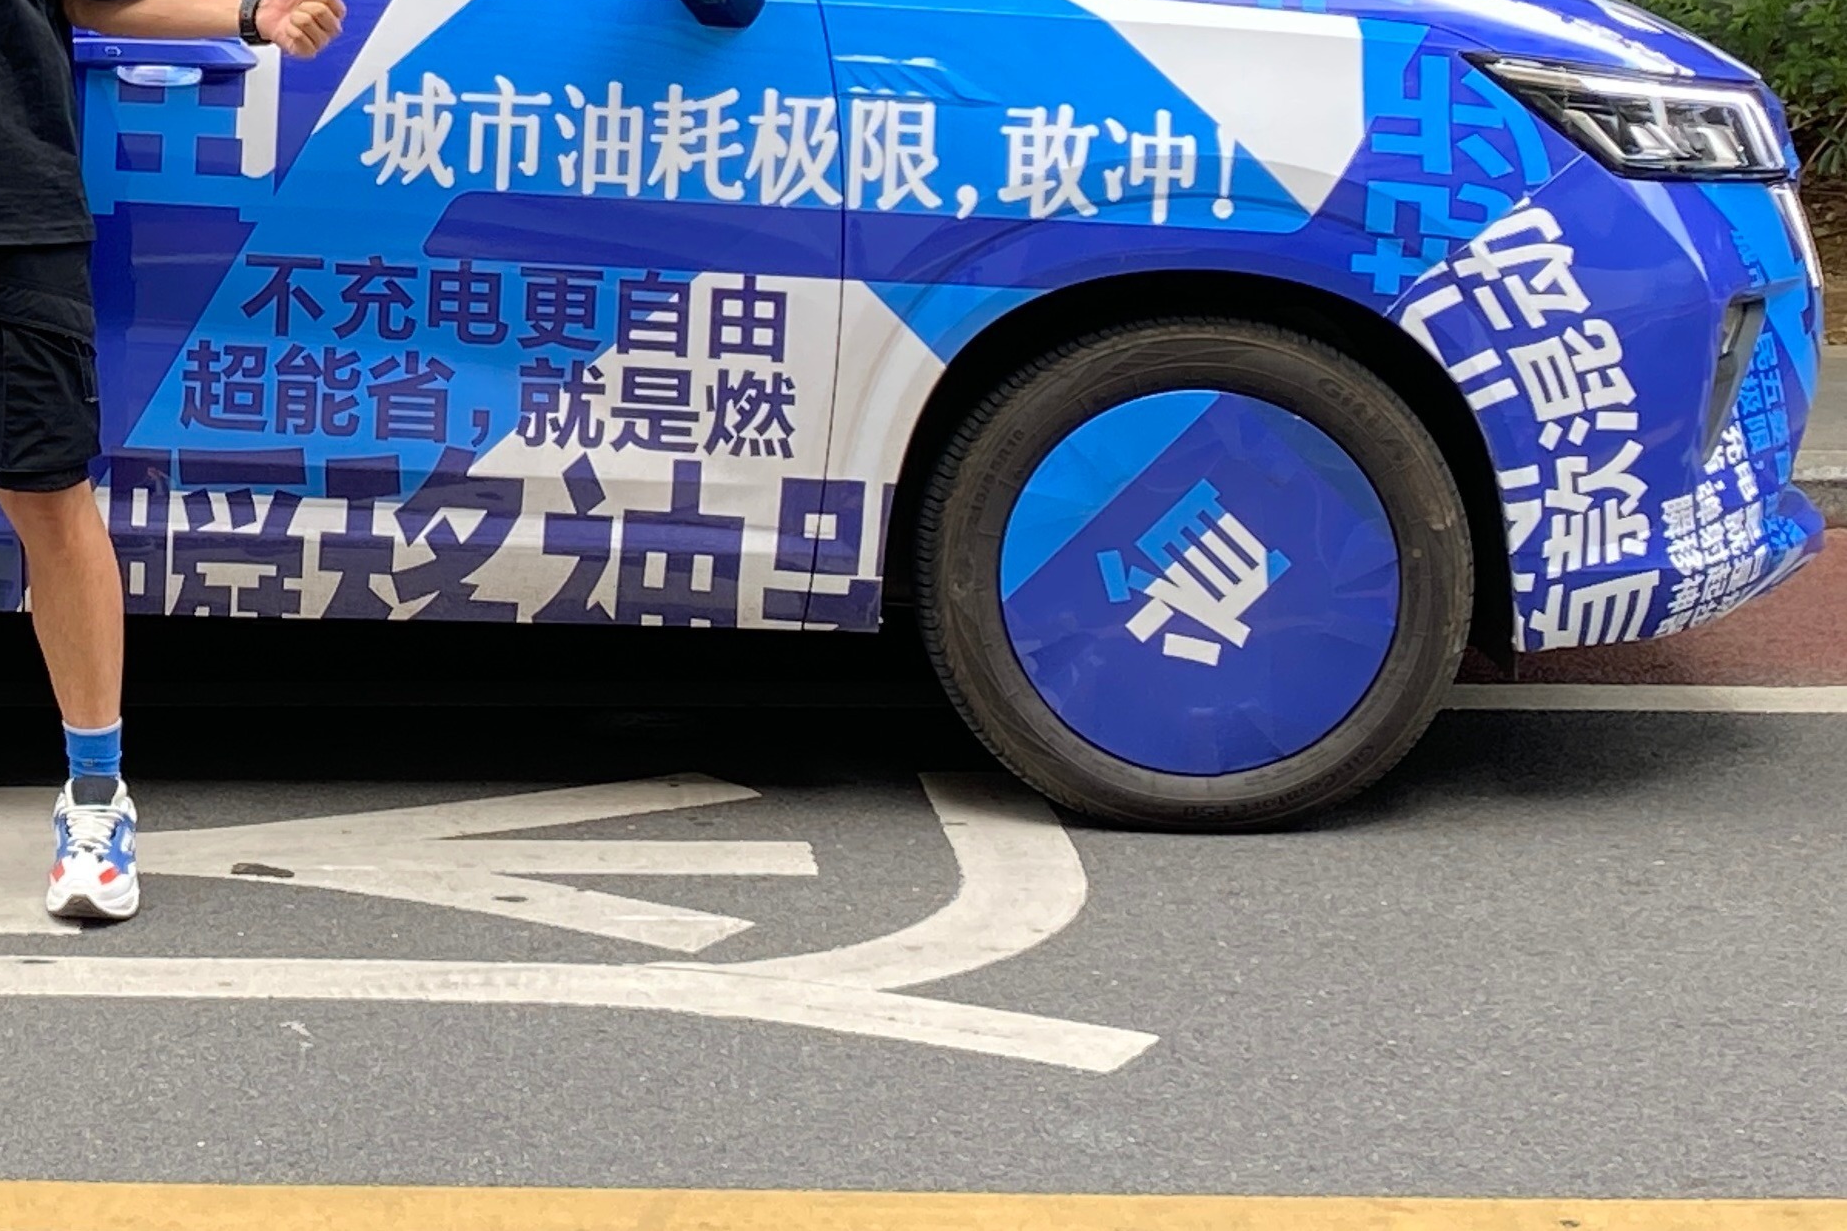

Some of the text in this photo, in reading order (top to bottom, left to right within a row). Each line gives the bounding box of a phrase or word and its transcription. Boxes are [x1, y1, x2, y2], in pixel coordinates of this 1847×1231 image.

[241, 252, 789, 366] 不充电更自由
[179, 340, 798, 461] 超能省，就是燃
[1095, 477, 1293, 668] 省
